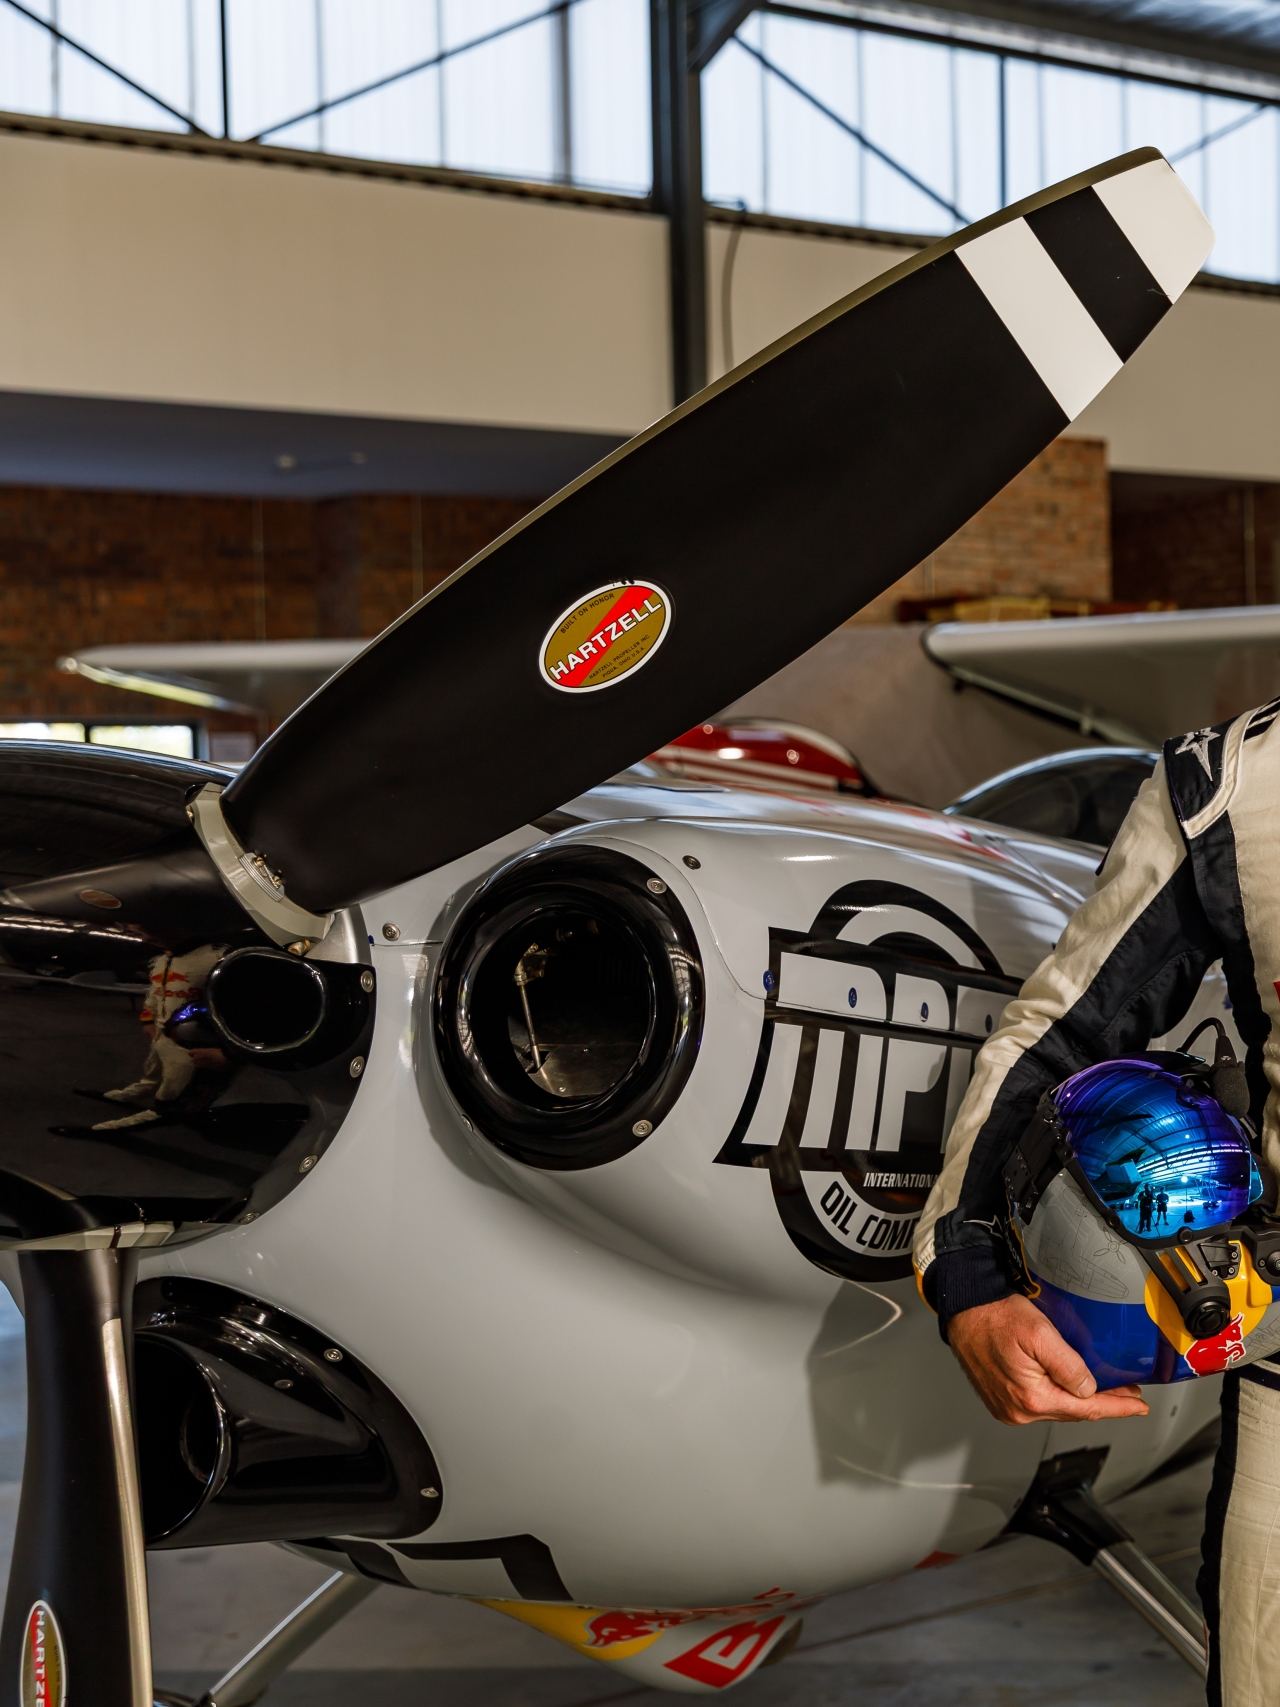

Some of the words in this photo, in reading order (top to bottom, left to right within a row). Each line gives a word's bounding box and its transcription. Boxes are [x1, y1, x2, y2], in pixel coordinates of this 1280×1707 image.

[560, 615, 578, 634] BUILT
[578, 607, 589, 617] ON
[589, 593, 615, 609] HONOR
[549, 598, 663, 681] HARTZELL
[589, 662, 613, 679] HARTZELL
[612, 641, 640, 662] PROPELLER
[640, 634, 652, 643] INC.
[819, 1180, 859, 1236] OIL
